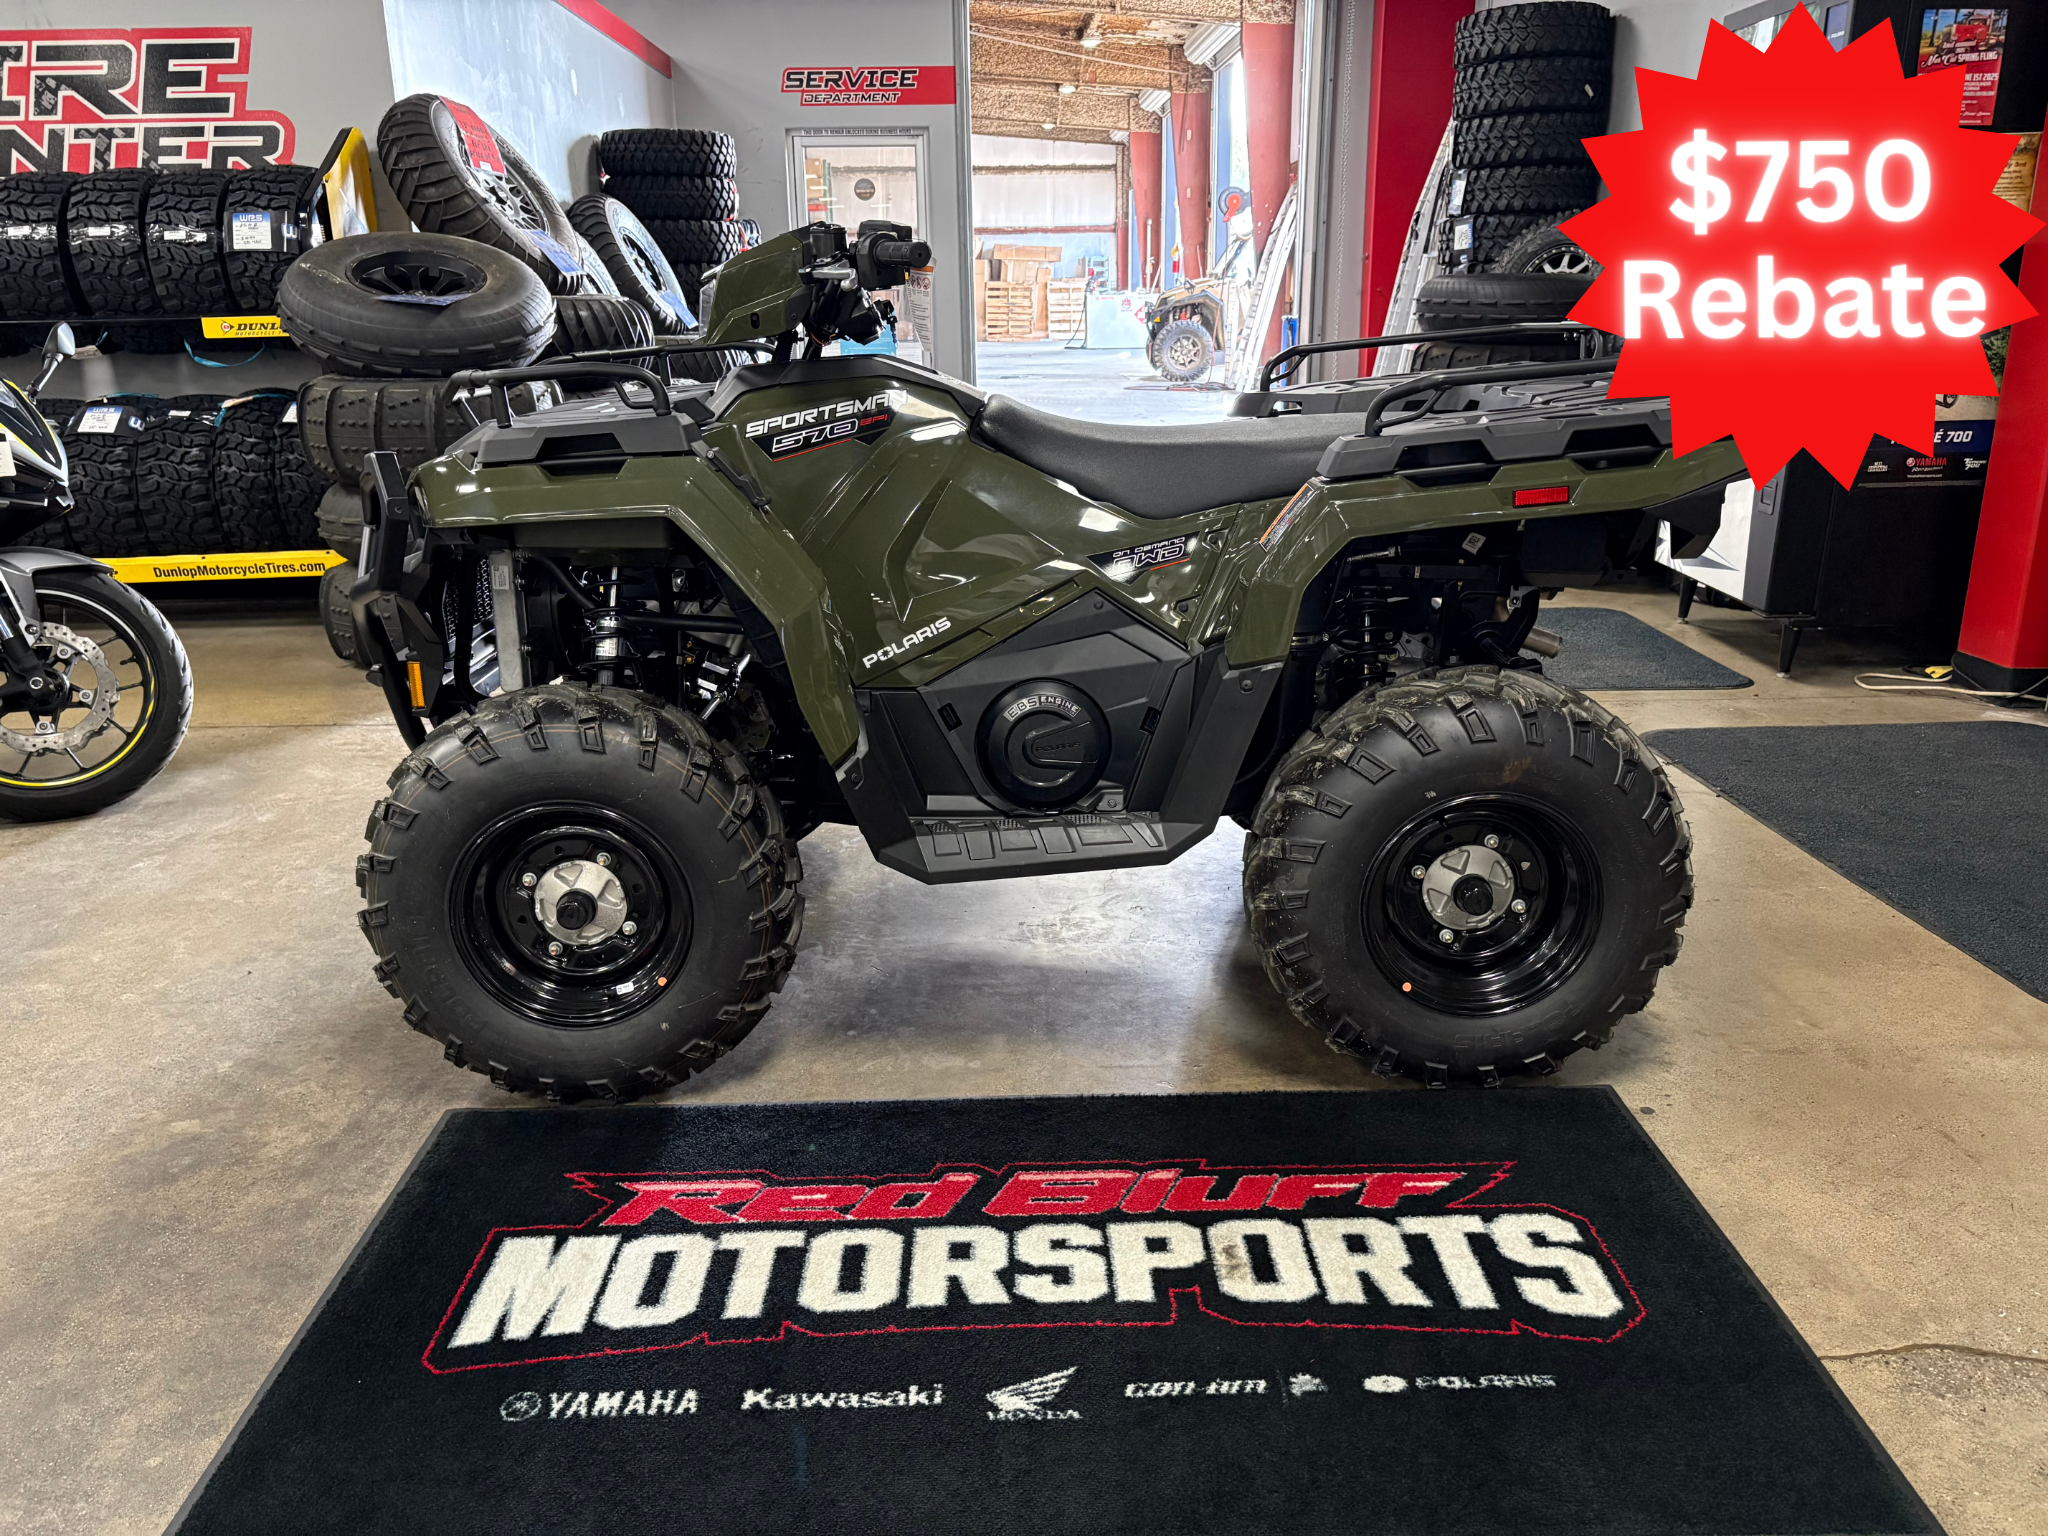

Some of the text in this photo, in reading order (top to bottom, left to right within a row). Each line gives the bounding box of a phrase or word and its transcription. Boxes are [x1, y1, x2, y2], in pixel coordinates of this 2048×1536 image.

[1980, 51, 1998, 60] FLING
[785, 69, 919, 90] SERVICE
[1983, 72, 1998, 80] 2025
[803, 92, 900, 104] DEPARTMENT
[240, 214, 263, 222] WPS
[236, 322, 281, 331] DUNL
[745, 389, 909, 438] SPORTSMAN
[772, 418, 858, 453] 570
[1945, 431, 1973, 443] 700
[1916, 457, 1947, 466] YAMAHA
[1113, 537, 1185, 558] ON DEMAND
[153, 562, 326, 578] DunlopMotorcycleTires.com
[862, 616, 952, 669] POLARIS
[1007, 696, 1079, 719] EBS ENGINE
[1035, 742, 1081, 752] POLARIS
[602, 1168, 1466, 1226] Red Bluff
[448, 1212, 1624, 1349] MOTORSPORTS
[548, 1388, 699, 1419] YAMAHA
[740, 1383, 943, 1413] Kawasaki
[1415, 1373, 1558, 1391] POLARIS
